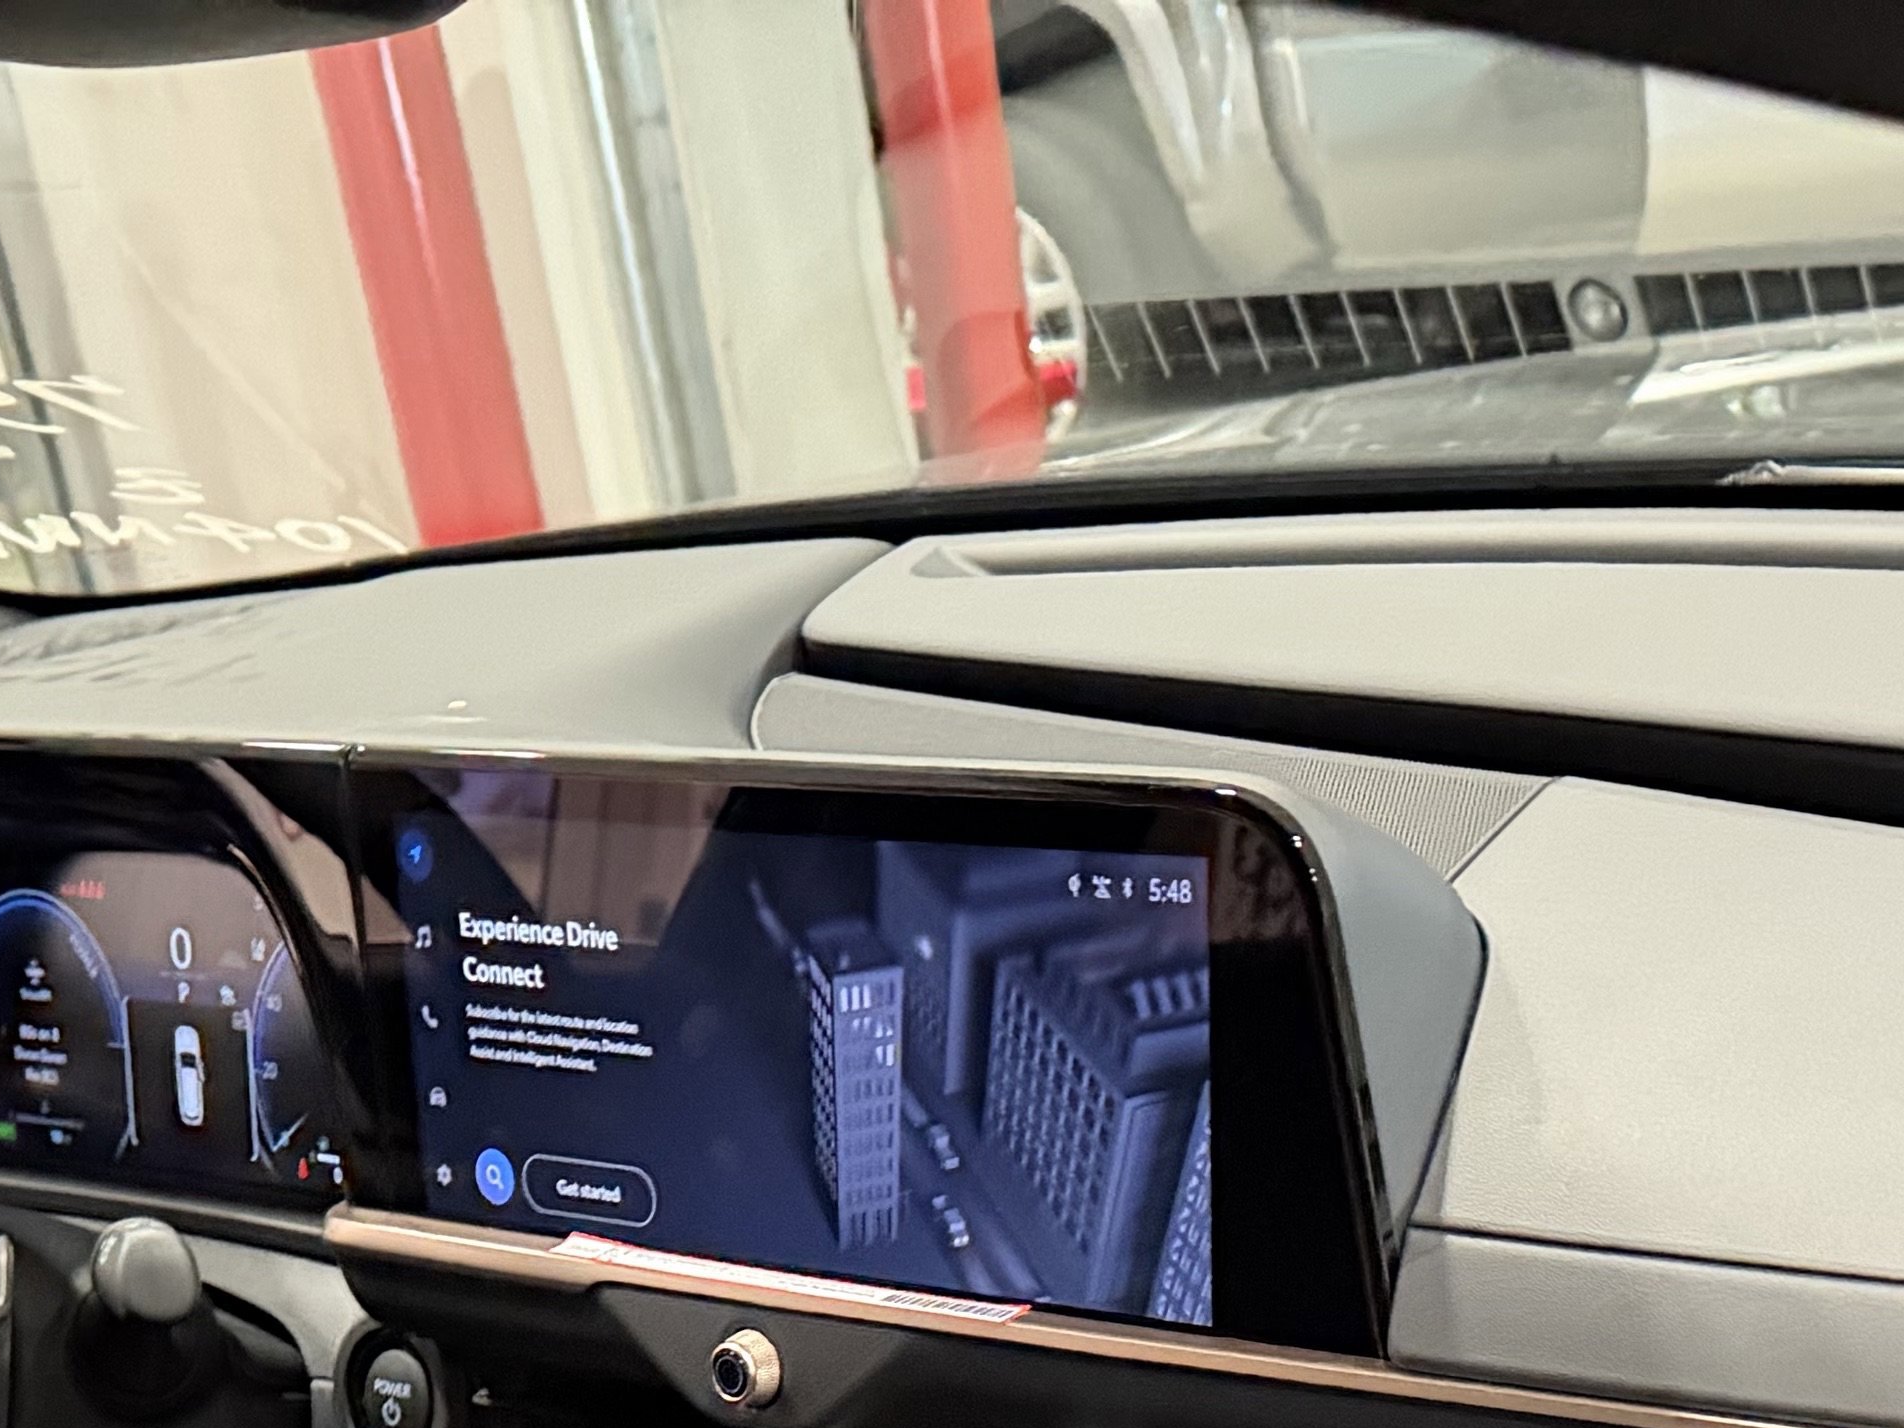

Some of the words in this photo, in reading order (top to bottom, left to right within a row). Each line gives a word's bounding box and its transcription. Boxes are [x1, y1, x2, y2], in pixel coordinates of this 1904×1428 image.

[1149, 877, 1192, 903] 5:48
[458, 912, 565, 946] Experience
[566, 921, 619, 951] Drive
[169, 927, 192, 970] 0
[462, 956, 545, 989] Connect
[556, 1179, 580, 1197] Get
[580, 1184, 622, 1203] started
[373, 1377, 412, 1399] POWER
